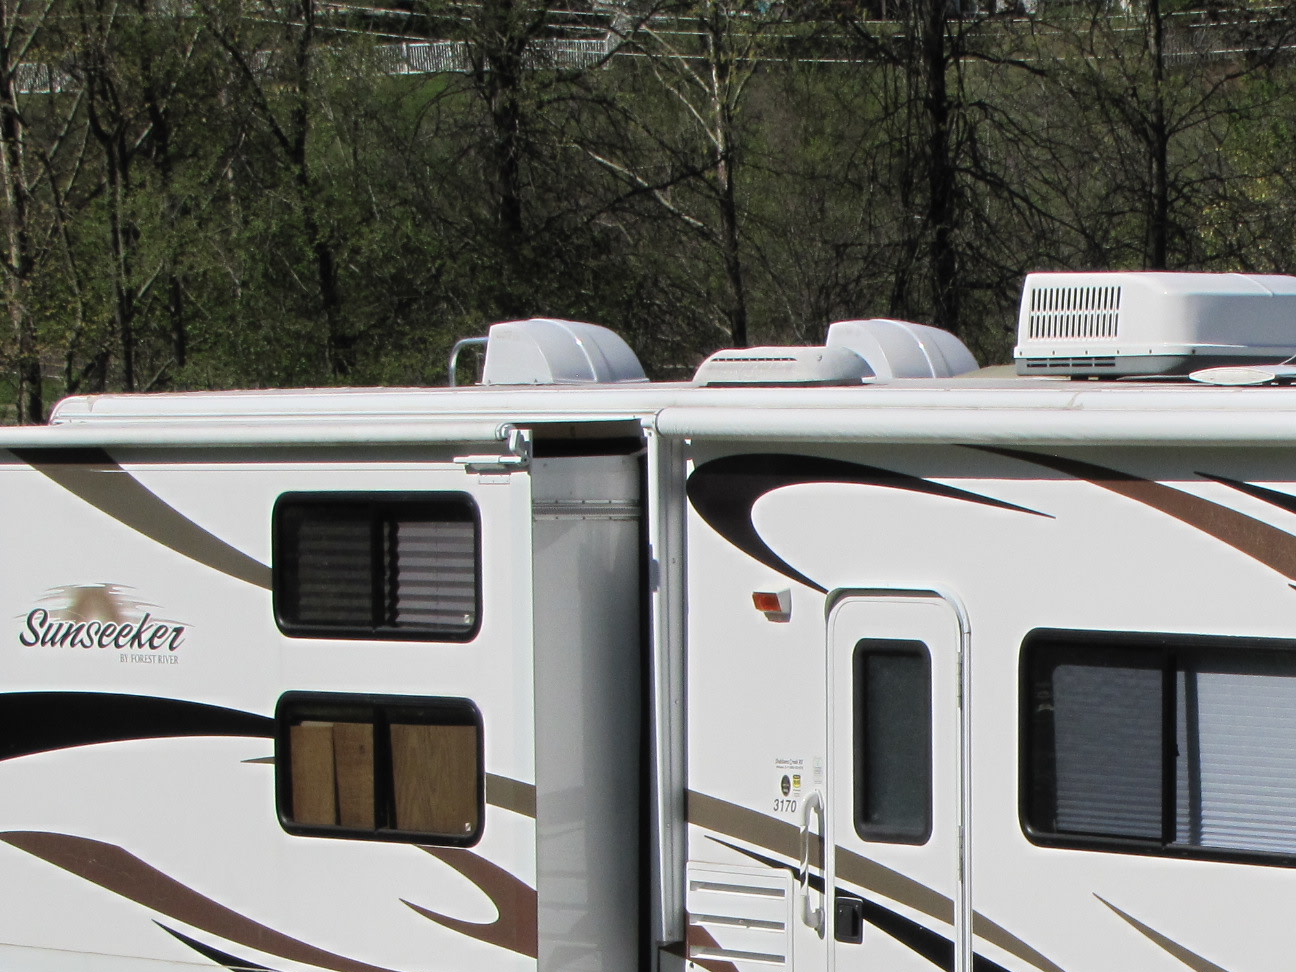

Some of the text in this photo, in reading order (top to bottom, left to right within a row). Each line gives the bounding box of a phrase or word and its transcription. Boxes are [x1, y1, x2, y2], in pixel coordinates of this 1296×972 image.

[19, 608, 186, 652] Sunseeker
[120, 653, 179, 665] BY FOREST RIVER
[773, 798, 797, 813] 3170
